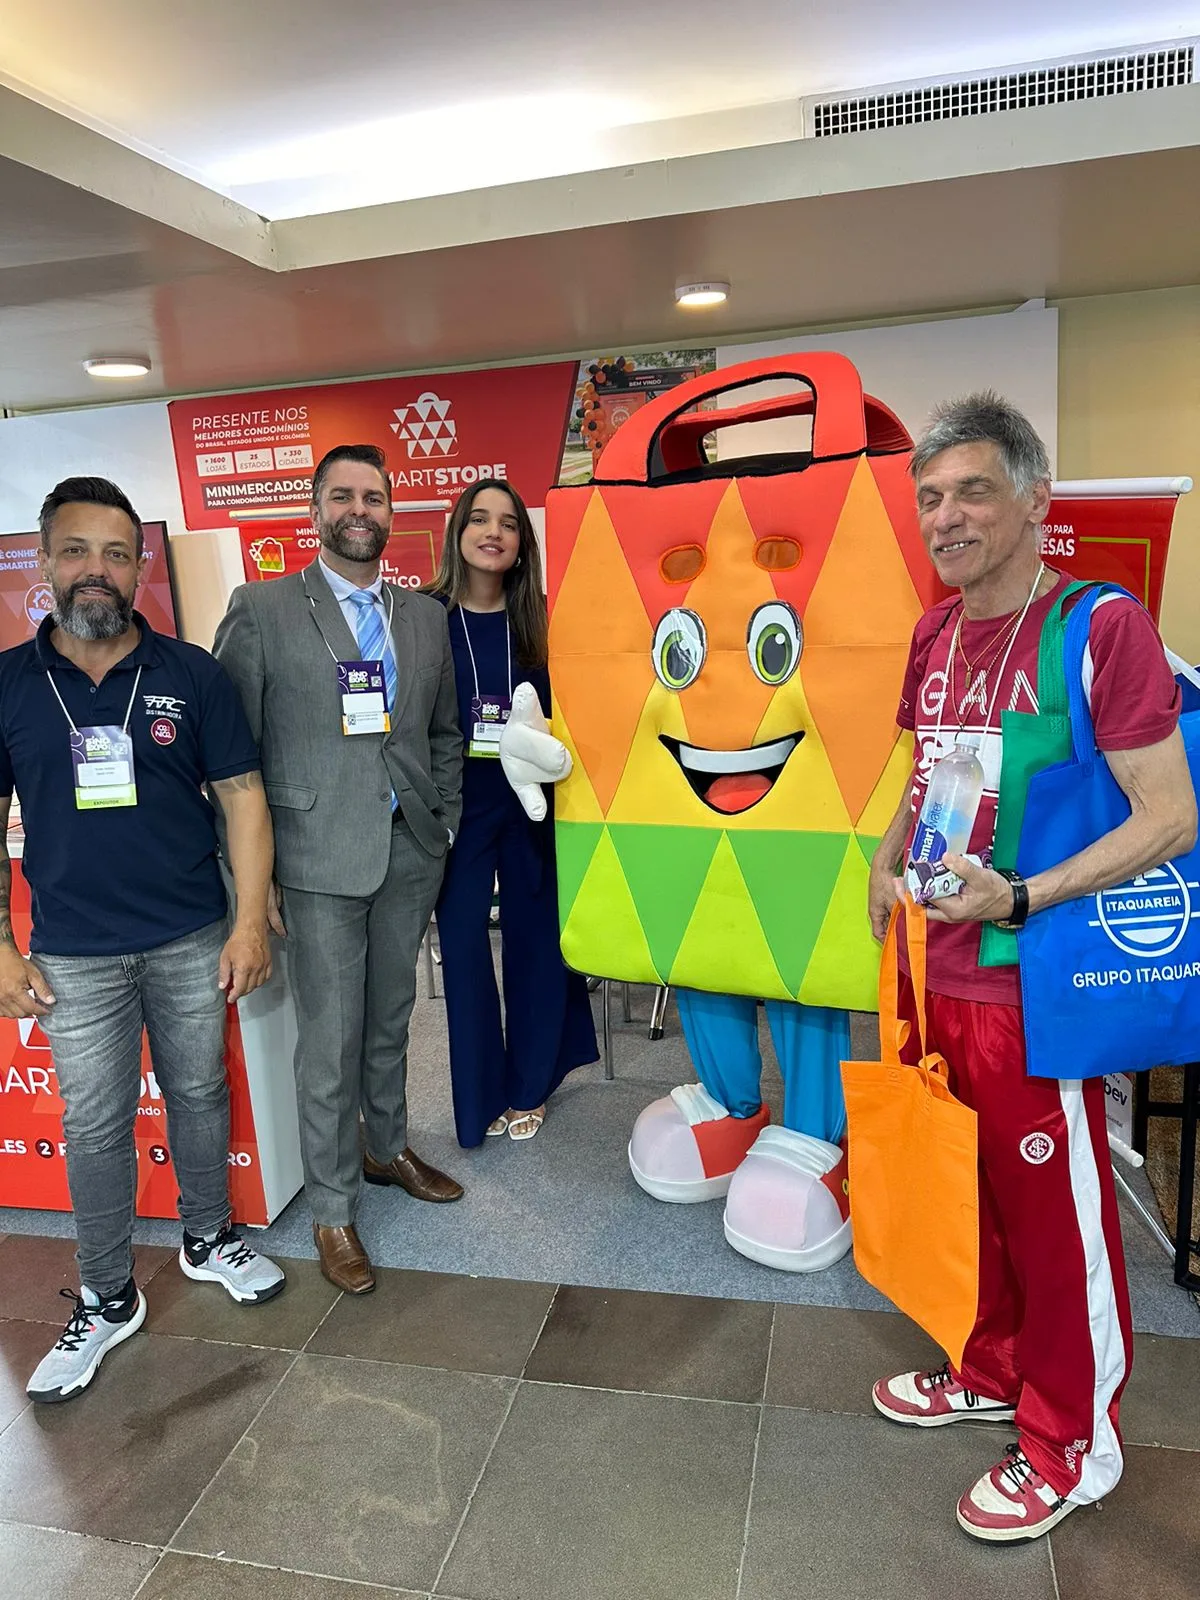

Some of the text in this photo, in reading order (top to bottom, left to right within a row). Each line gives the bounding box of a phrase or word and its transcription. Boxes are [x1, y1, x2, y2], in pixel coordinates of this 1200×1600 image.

[192, 406, 308, 430] PRESENTE NOS
[194, 422, 310, 441] MELHORES CONDOMÍNIOS
[227, 438, 252, 446] ESTADOS
[210, 456, 226, 464] 1600
[240, 460, 271, 470] ESTADOS
[278, 457, 309, 466] CIDADES
[206, 464, 227, 472] LOJAS
[206, 479, 313, 498] MINIMERCADOS
[437, 485, 467, 496] Simplifi
[207, 498, 226, 507] PARA
[226, 494, 273, 506] CONDOMÍNIOS
[296, 528, 320, 536] MINI
[1041, 524, 1074, 535] DO PARA
[1040, 537, 1075, 557] ESAS
[5, 549, 38, 559] CONHE
[0, 560, 40, 570] SMARTST
[380, 559, 399, 575] IL,
[382, 575, 421, 589] TICO
[1106, 896, 1181, 912] ITAQUAREIA
[1073, 962, 1200, 988] GRUPO ITAQUAR
[1103, 1077, 1128, 1106] bev
[137, 1105, 161, 1116] ndo
[39, 1142, 52, 1155] 2
[153, 1148, 165, 1161] 3
[228, 1152, 252, 1167] RO
